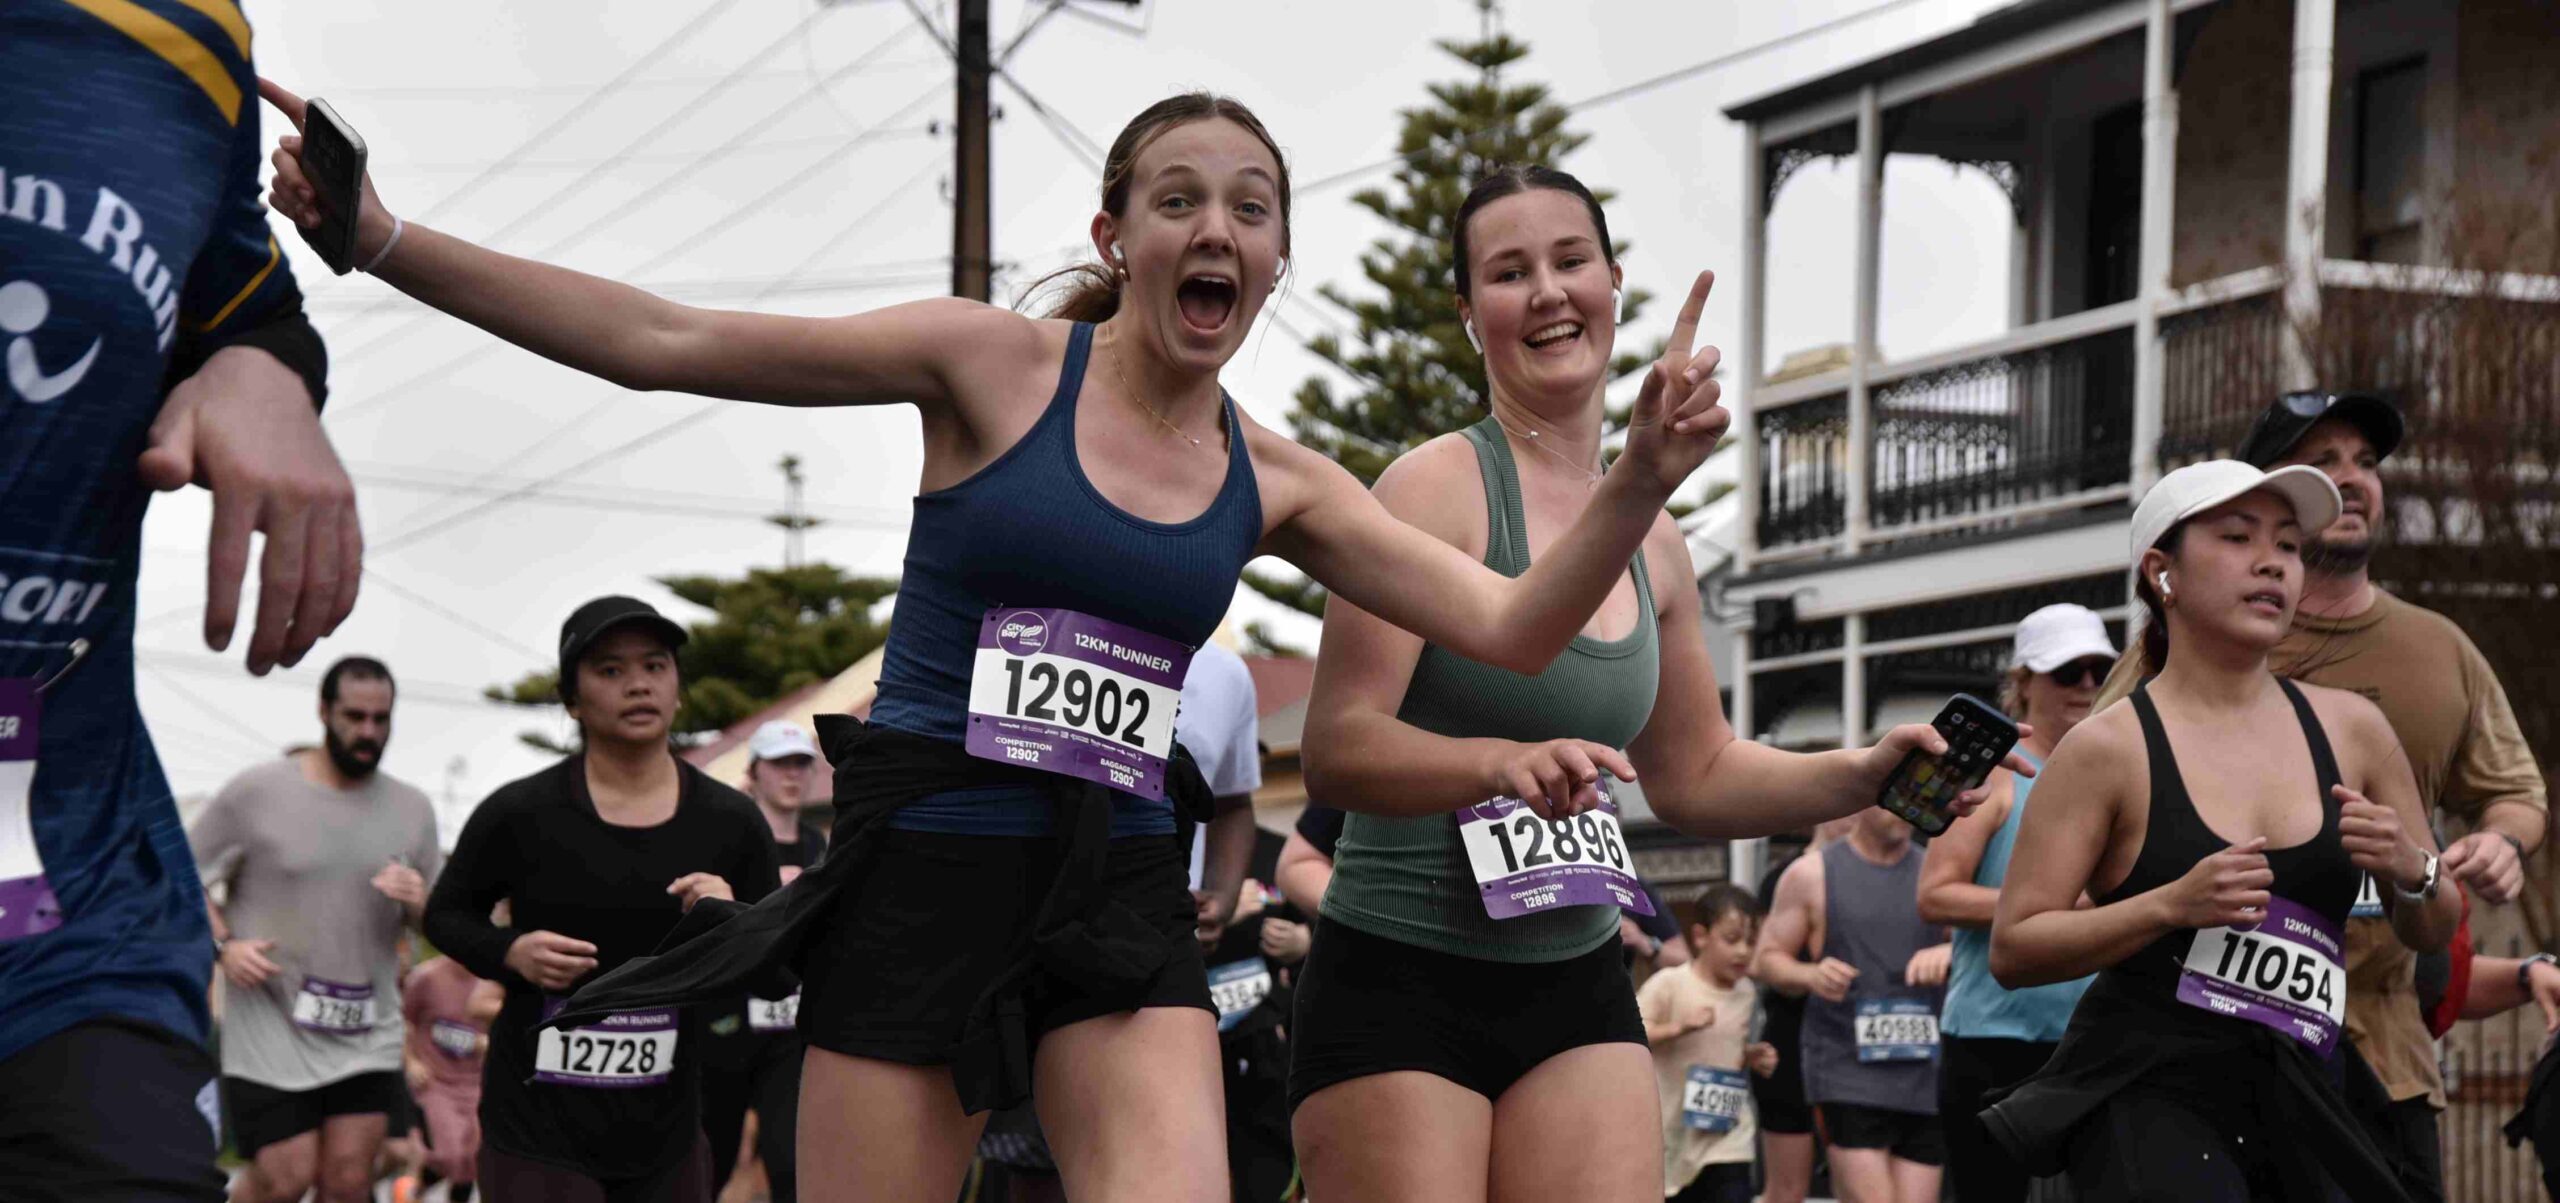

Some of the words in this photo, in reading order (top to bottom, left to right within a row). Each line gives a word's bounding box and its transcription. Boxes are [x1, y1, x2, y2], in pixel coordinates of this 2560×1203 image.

[80, 186, 179, 353] Run
[1001, 629, 1019, 638] Bay
[1006, 623, 1026, 632] City
[1074, 632, 1109, 655] 12KM
[1112, 645, 1172, 674] RUNNER
[1005, 658, 1150, 748] 12902
[995, 736, 1053, 752] COMPETITION
[1006, 746, 1039, 763] 12902
[1100, 757, 1131, 775] BAGGAGE
[1132, 767, 1145, 780] TAG
[1109, 769, 1135, 789] 12902
[1488, 813, 1624, 874] 12896
[1510, 883, 1565, 900] COMPETITION
[1523, 892, 1557, 909] 12896
[2284, 917, 2312, 938] 12KM
[2312, 928, 2340, 957] RUNNER
[2216, 931, 2333, 1013] 11054
[629, 1014, 671, 1026] RUNNER
[559, 1033, 657, 1074] 12728
